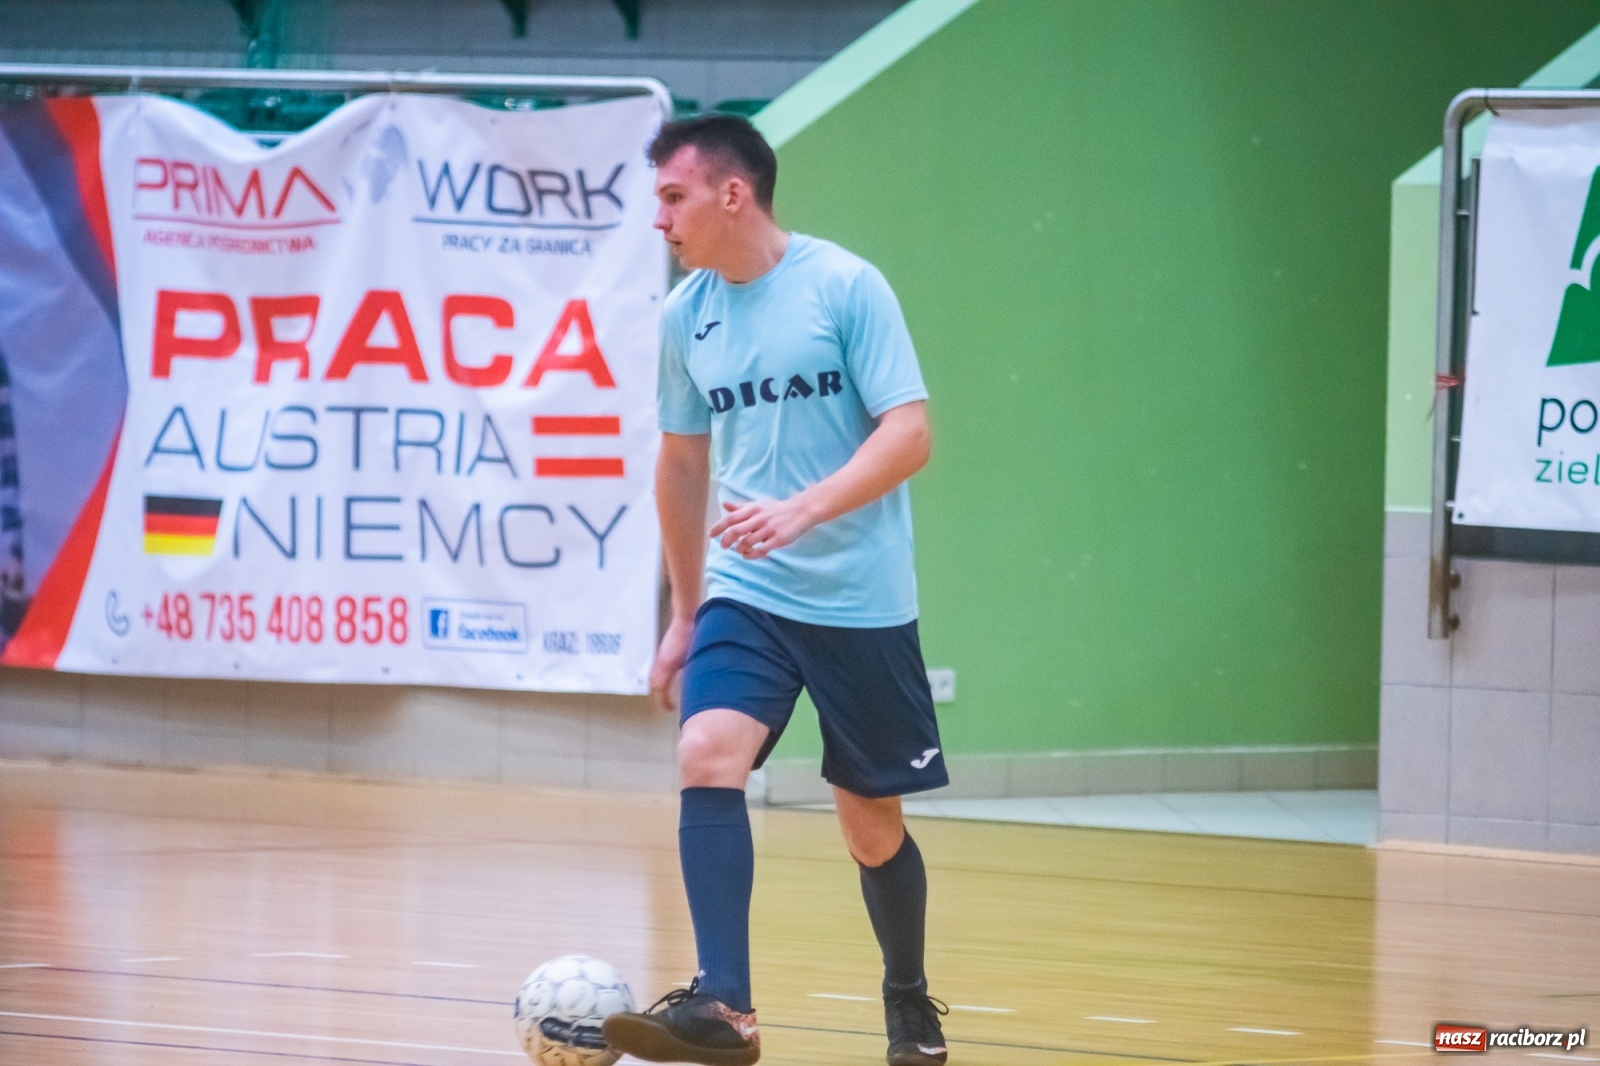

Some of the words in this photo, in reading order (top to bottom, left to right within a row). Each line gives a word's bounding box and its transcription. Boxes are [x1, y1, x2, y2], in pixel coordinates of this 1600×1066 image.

[134, 157, 338, 219] PRIMA
[416, 158, 626, 220] WORK
[443, 234, 492, 252] PRACY
[498, 237, 520, 253] ZA
[150, 289, 618, 390] PRACA
[708, 370, 843, 414] DICAR
[144, 405, 519, 480] AUSTRIA
[1537, 397, 1599, 447] po
[1535, 451, 1600, 486] ziel
[232, 496, 629, 570] NIEMCY
[142, 592, 194, 641] +48
[200, 593, 256, 642] 735
[267, 595, 323, 643] 408
[335, 596, 408, 645] 858
